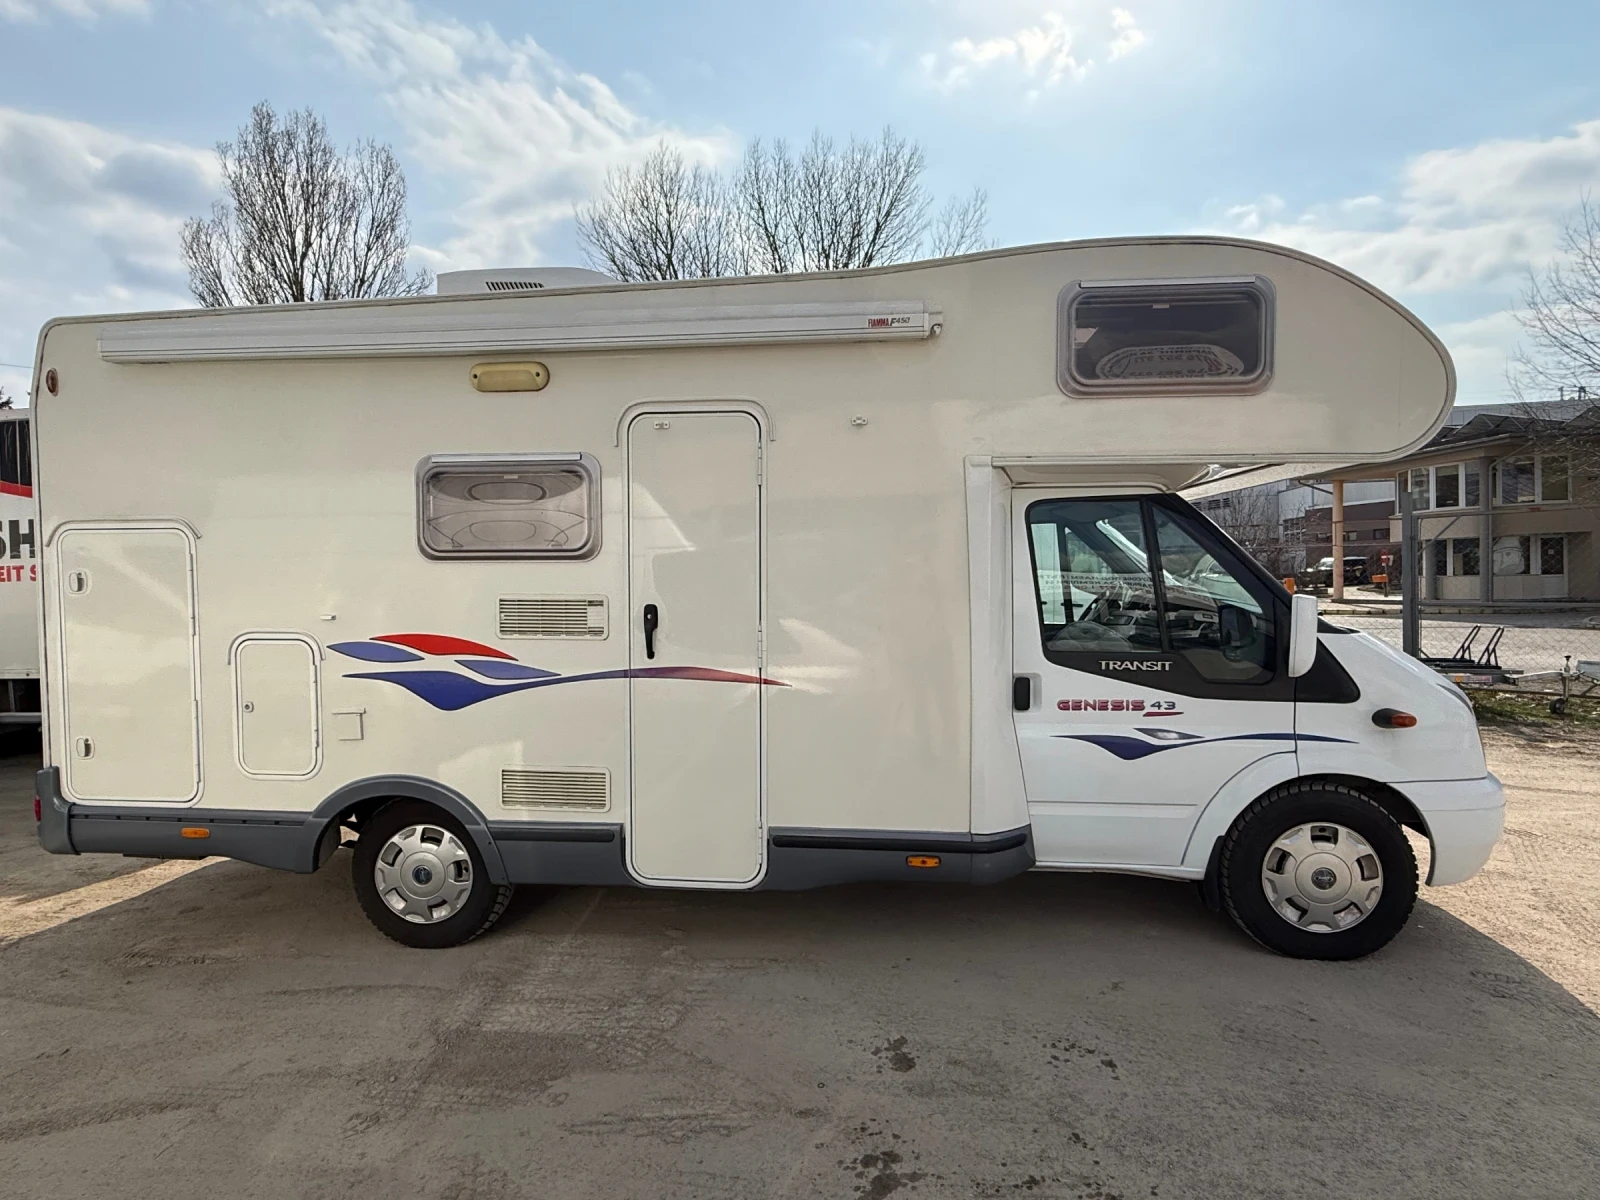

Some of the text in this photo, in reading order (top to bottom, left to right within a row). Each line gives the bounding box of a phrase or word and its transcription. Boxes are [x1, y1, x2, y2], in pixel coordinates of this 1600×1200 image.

[1099, 660, 1173, 671] TRANSIT
[1057, 699, 1177, 712] GENESIS 43
